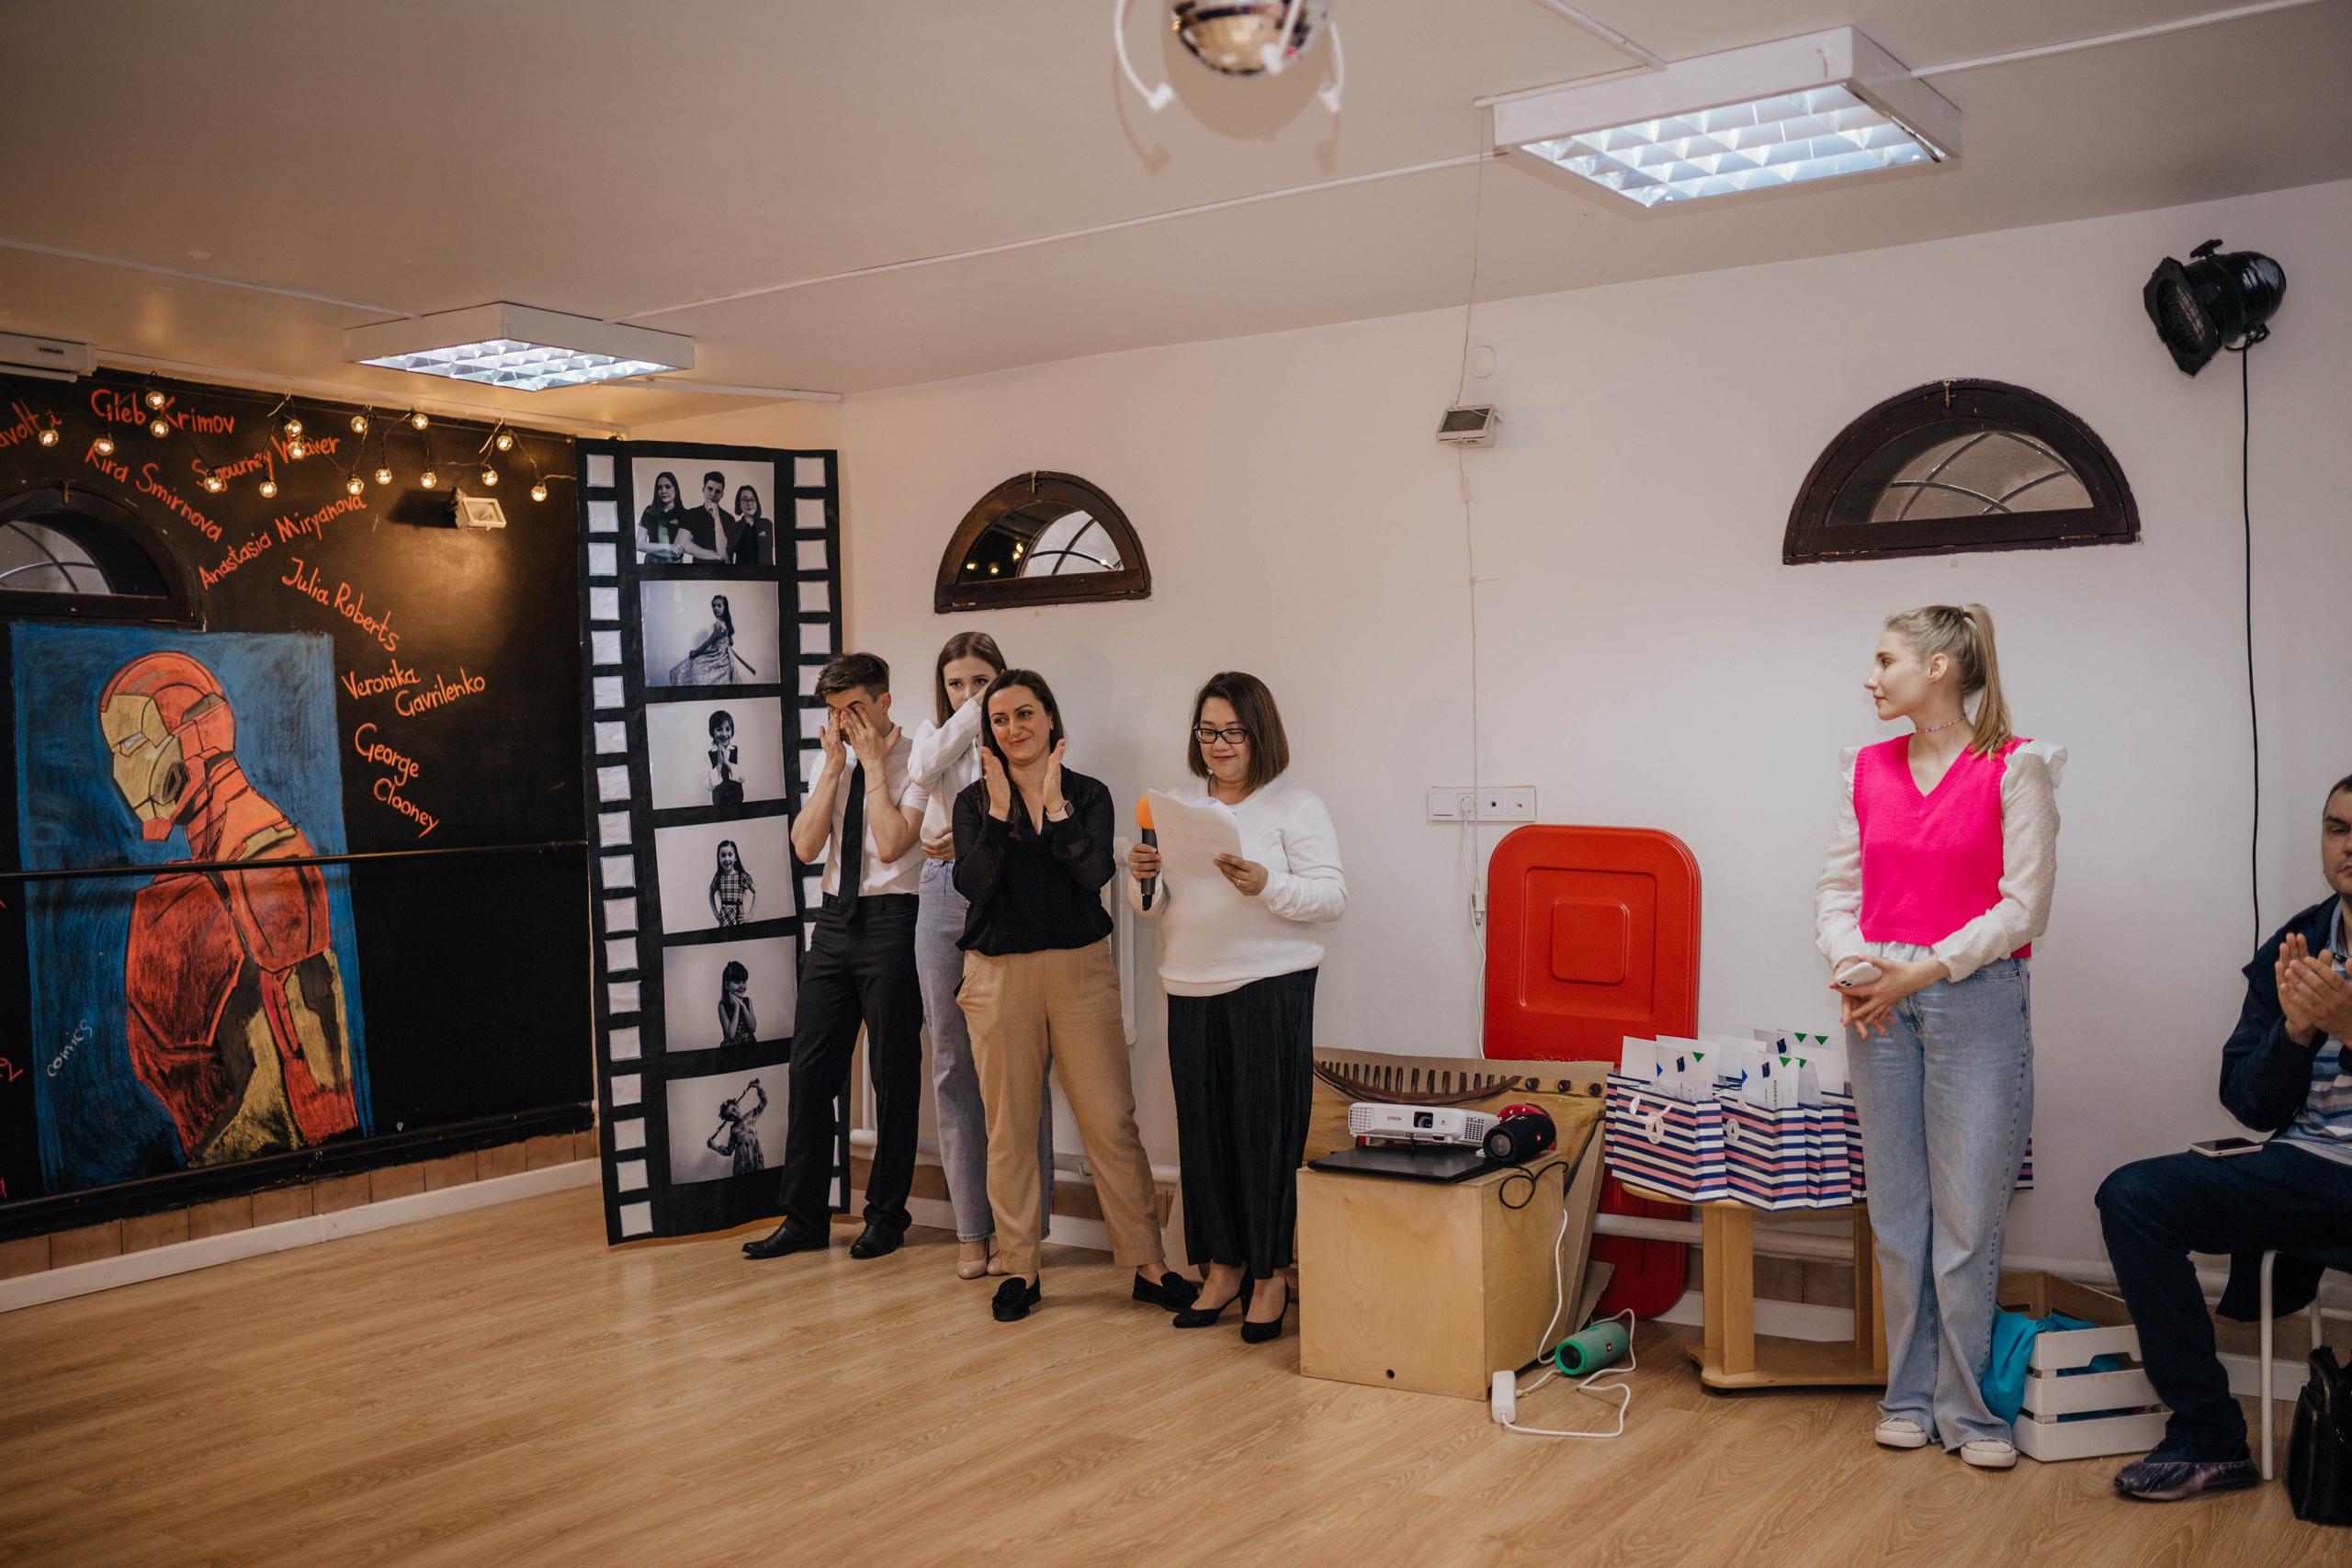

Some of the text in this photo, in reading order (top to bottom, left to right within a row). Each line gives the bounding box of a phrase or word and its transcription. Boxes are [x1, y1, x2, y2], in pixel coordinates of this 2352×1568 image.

[91, 389, 146, 426] Gleb
[135, 462, 222, 543] Smirnova
[198, 493, 368, 591] Anastasia Miryanova
[281, 557, 400, 652] Julia Roberts
[341, 659, 422, 700] Veronika
[395, 667, 486, 716] Gavrilenko
[355, 722, 419, 787] George
[373, 777, 439, 839] Clooney
